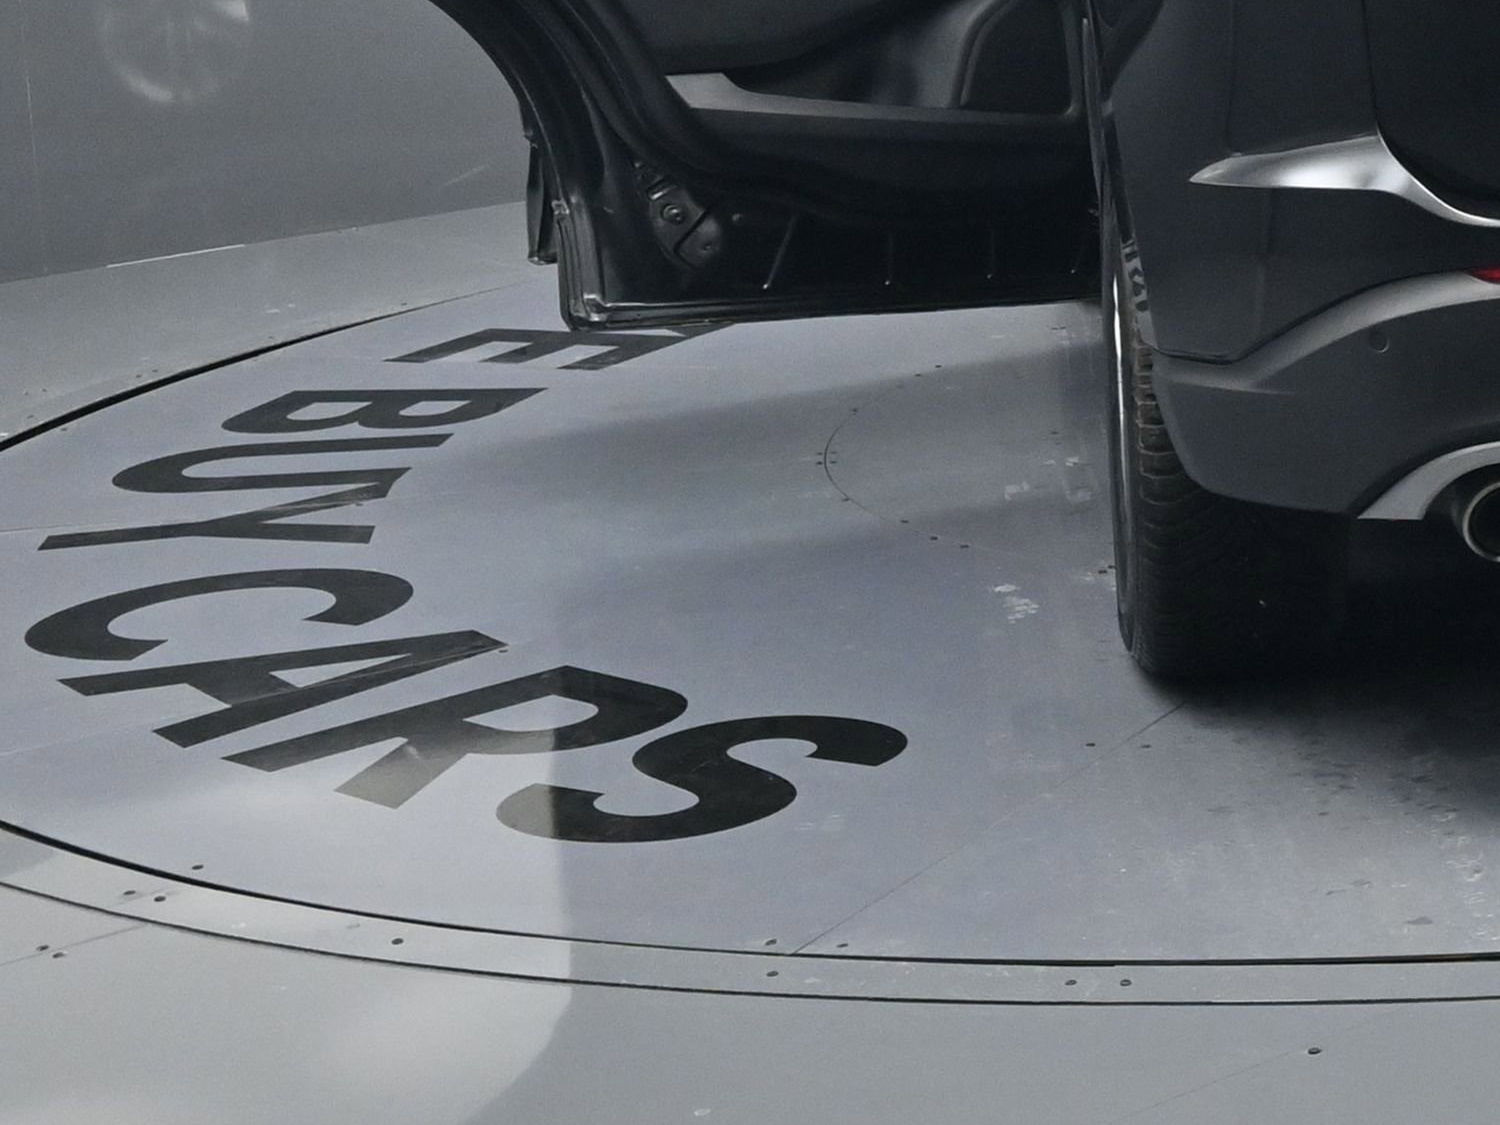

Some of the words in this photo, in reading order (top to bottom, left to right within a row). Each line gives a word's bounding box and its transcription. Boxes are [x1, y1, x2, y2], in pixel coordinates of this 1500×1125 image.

[383, 322, 735, 371] E
[37, 387, 549, 551] BUY
[24, 567, 909, 844] CARS
